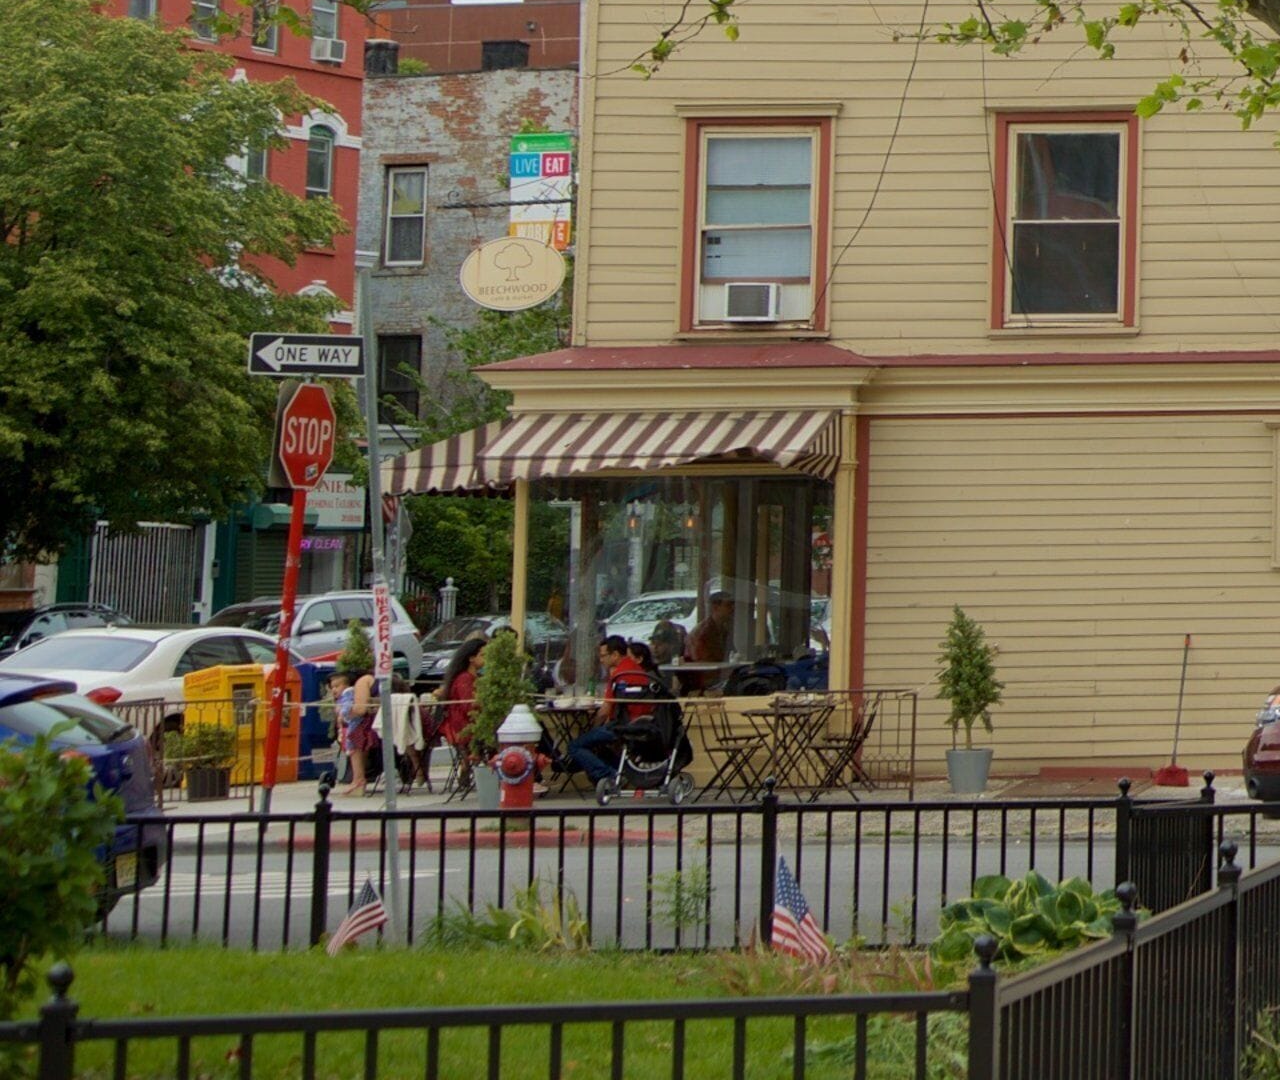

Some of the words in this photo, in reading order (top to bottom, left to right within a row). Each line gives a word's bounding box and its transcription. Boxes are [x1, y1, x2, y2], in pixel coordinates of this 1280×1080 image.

[515, 158, 539, 174] LIVE
[545, 157, 566, 173] EAT
[479, 283, 548, 296] BEECHWOOD
[274, 347, 308, 362] ONE
[318, 348, 352, 363] WAY
[285, 416, 332, 455] STOP
